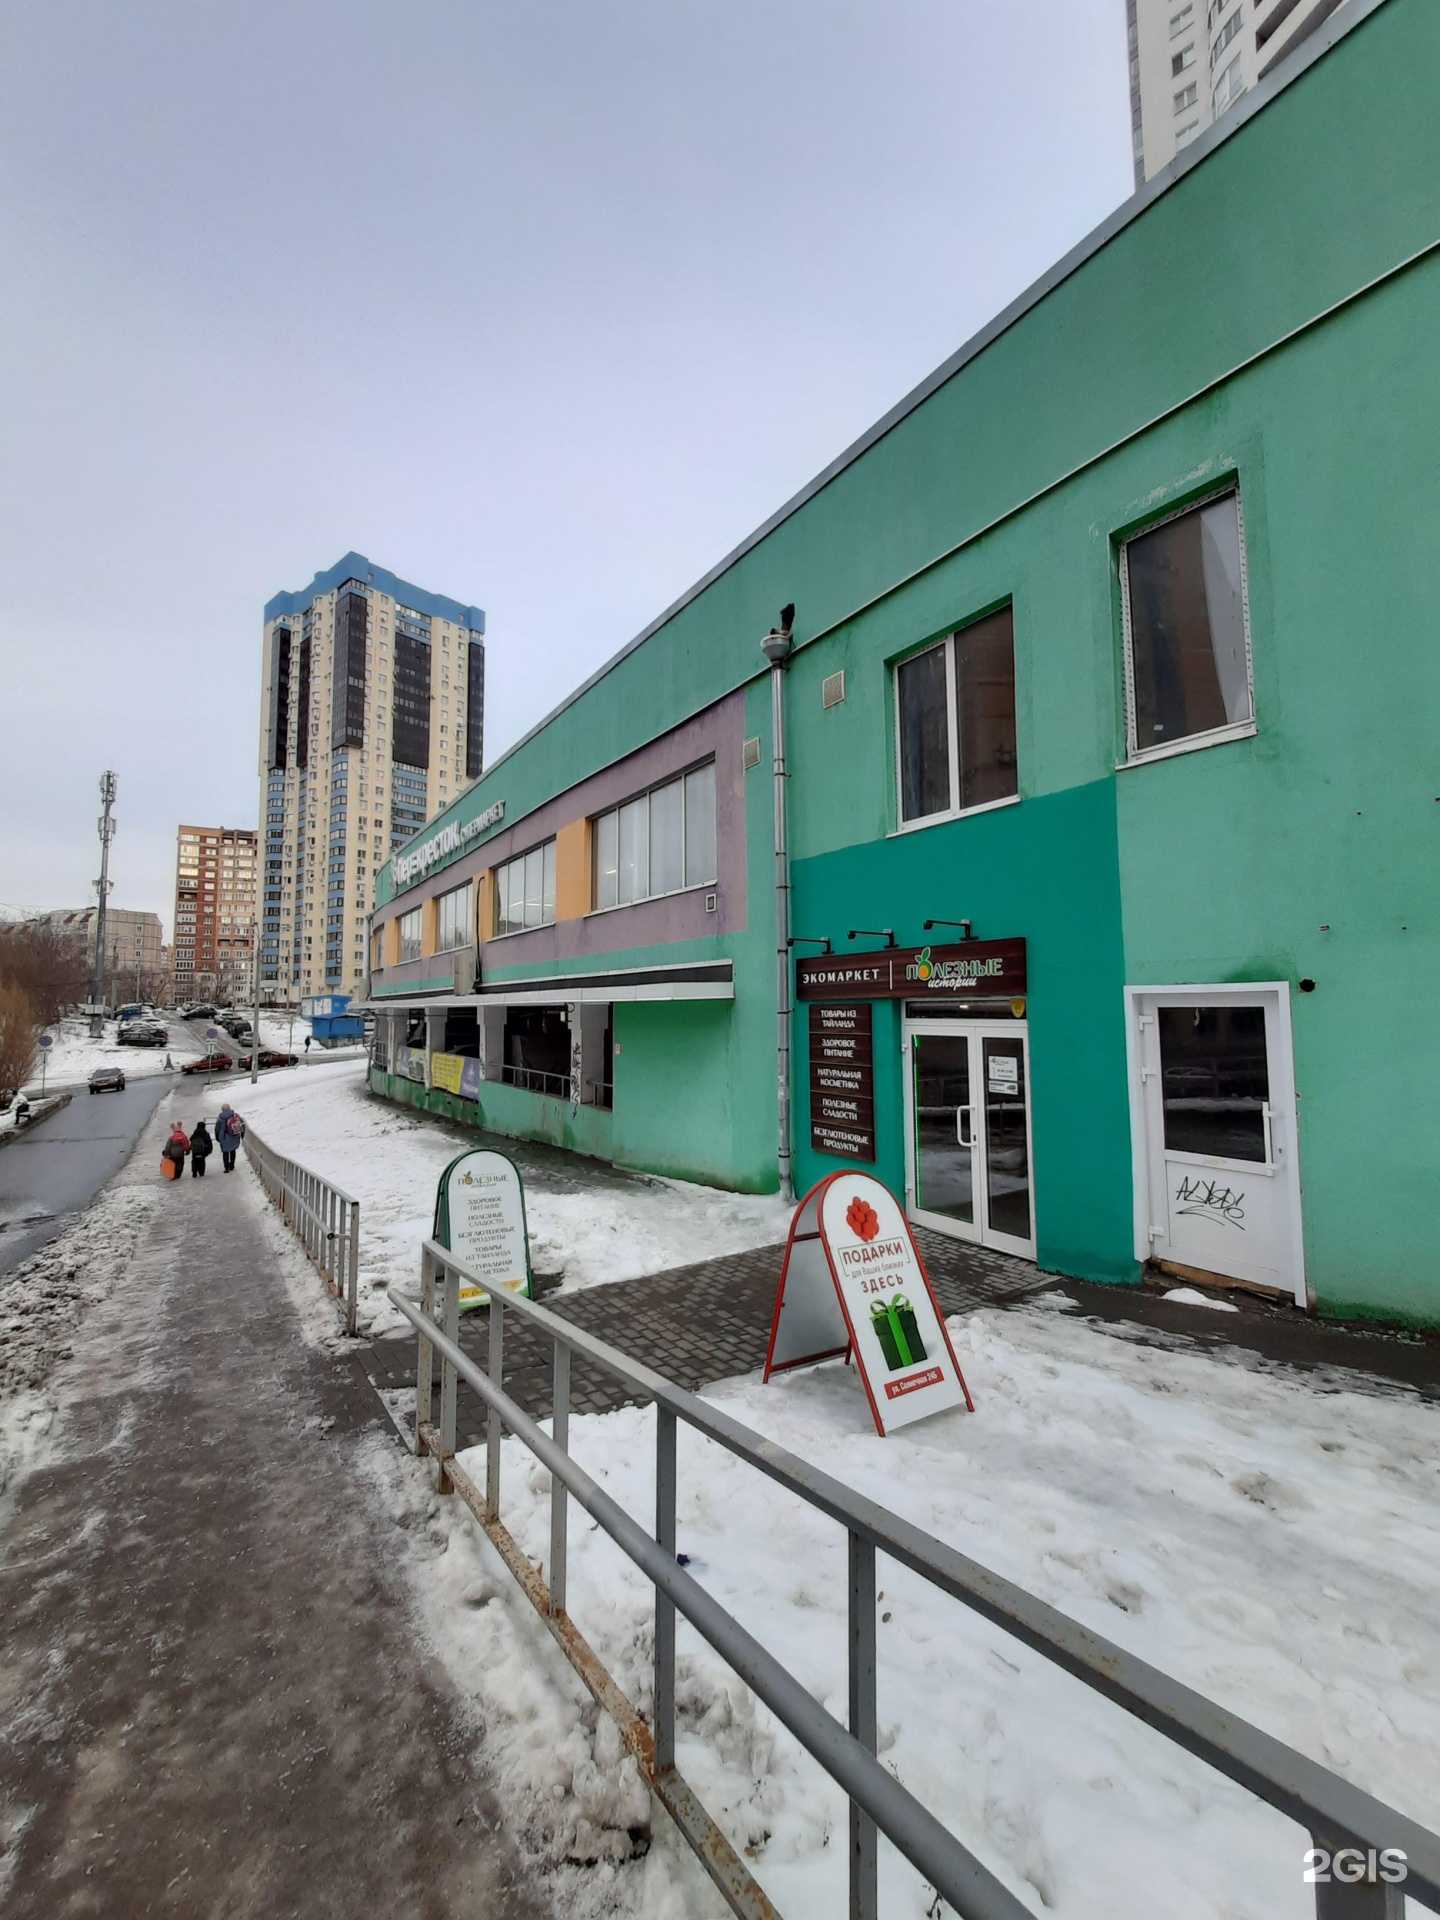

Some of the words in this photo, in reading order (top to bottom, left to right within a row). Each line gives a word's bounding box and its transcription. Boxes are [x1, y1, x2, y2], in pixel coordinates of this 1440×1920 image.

[905, 955, 1004, 982] ПОЛЕЗНЫЕ
[802, 968, 880, 985] ЭКОМАРКЕТ
[927, 976, 978, 991] истории
[820, 1009, 846, 1018] ТОВАРЫ
[847, 1010, 857, 1018] ИЗ
[822, 1019, 856, 1028] ТАЙЛАНДА
[821, 1038, 857, 1048] ЗДОРОВОЕ
[823, 1048, 855, 1058] ПИТАНИЕ
[817, 1067, 862, 1080] НАТУРАЛЬНАЯ
[820, 1078, 860, 1089] КОСМЕТИКА
[822, 1097, 858, 1110] ПОЛЕЗНЫЕ
[822, 1108, 858, 1120] СЛАДОСТИ
[813, 1126, 869, 1145] БЕЗГЛЮТЕНОВЫЕ
[823, 1138, 859, 1152] ПРОДУКТЫ
[842, 1241, 903, 1265] ПОДАРКИ
[861, 1274, 904, 1293] ЗДЕСЬ
